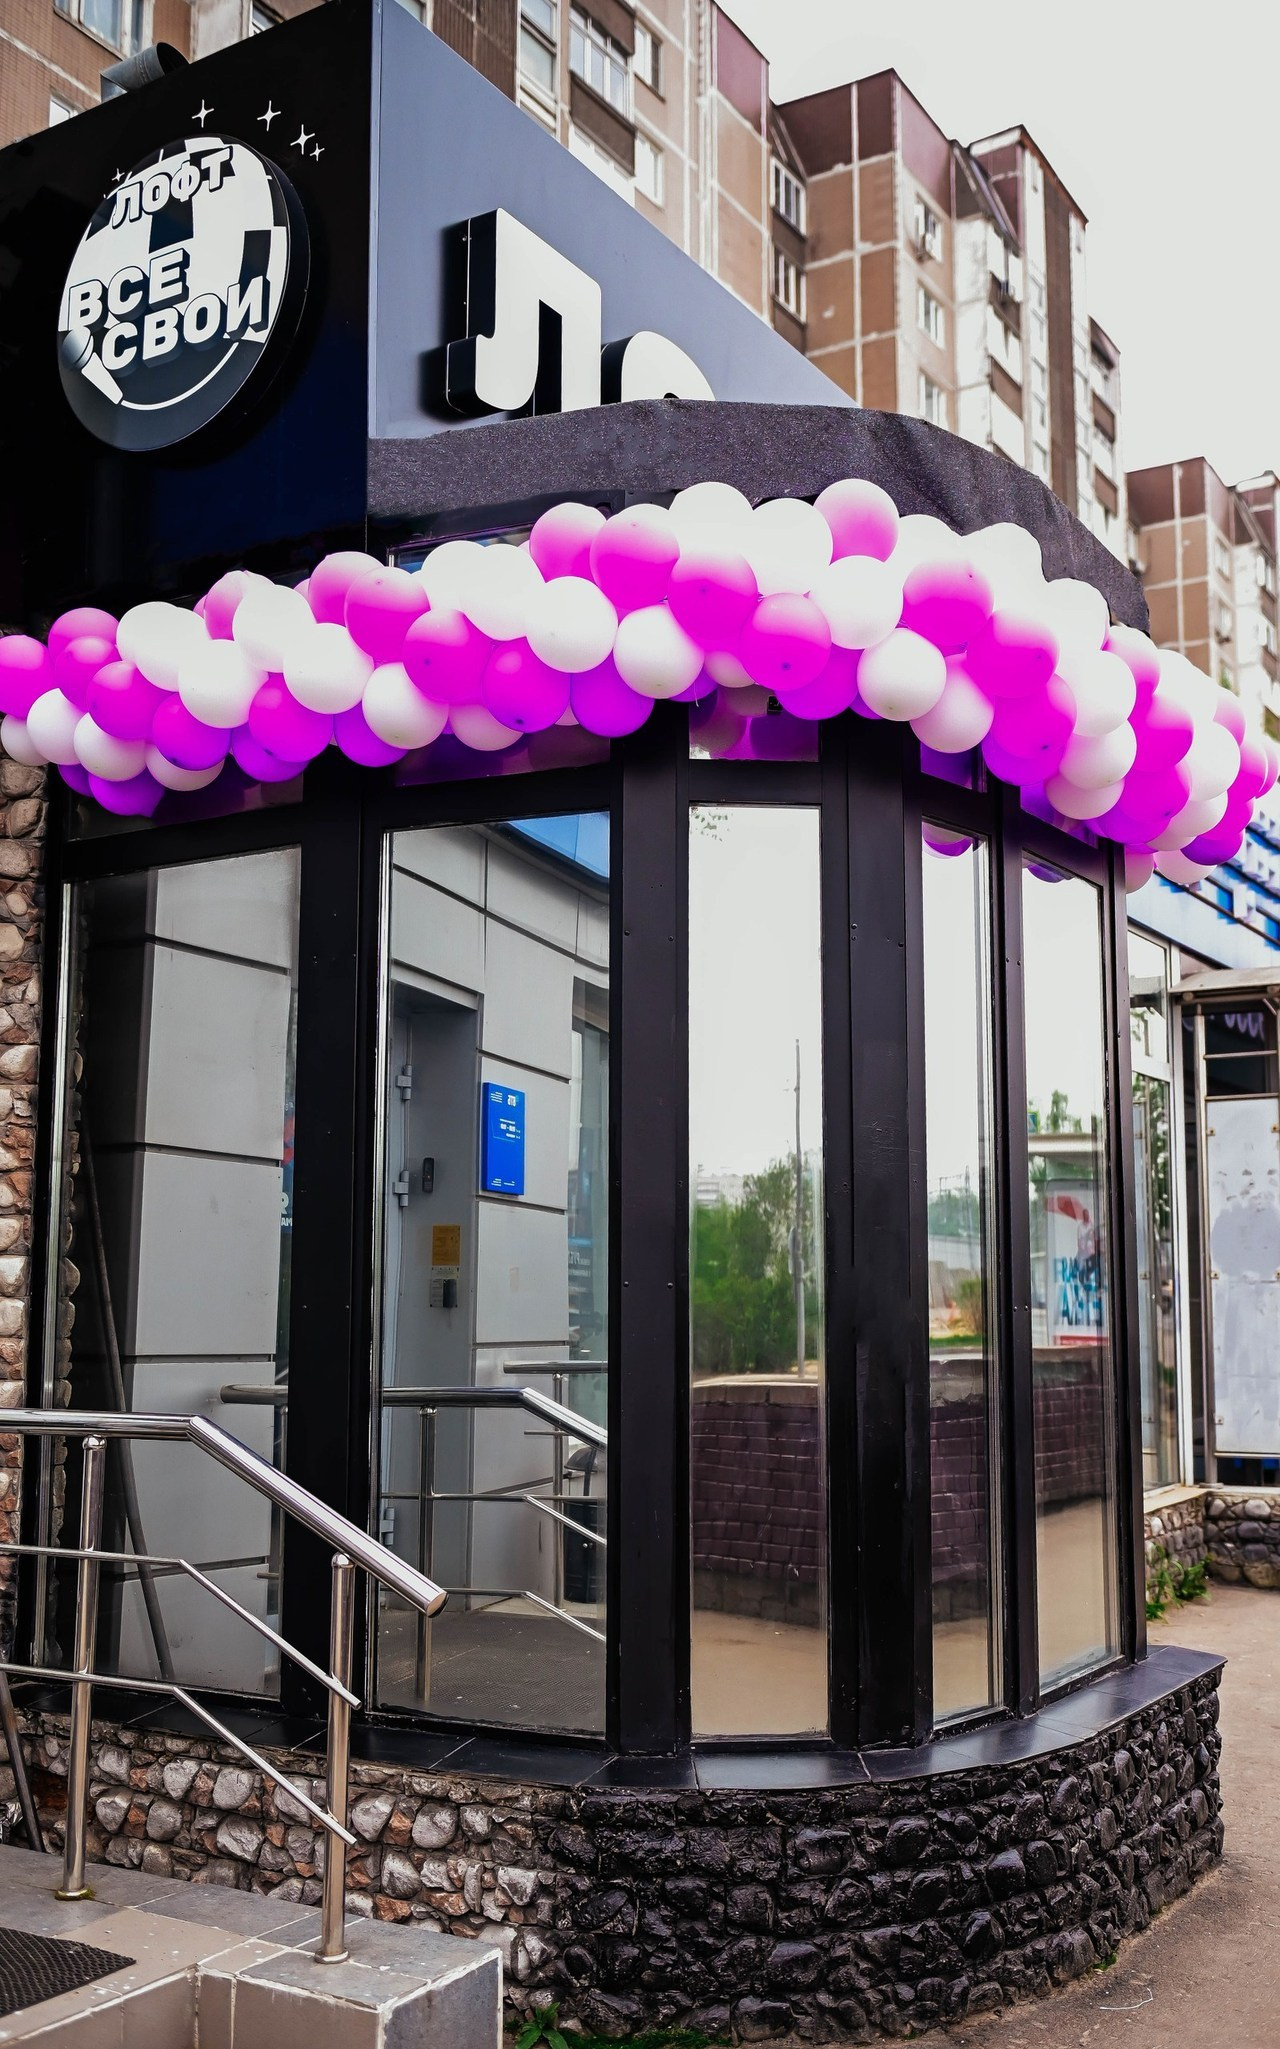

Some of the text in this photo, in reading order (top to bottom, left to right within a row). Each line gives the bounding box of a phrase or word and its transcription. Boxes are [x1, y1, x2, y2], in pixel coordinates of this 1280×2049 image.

[112, 147, 234, 228] ЛОФТ
[68, 248, 186, 332] ВСЕ
[102, 275, 267, 372] СВОИ
